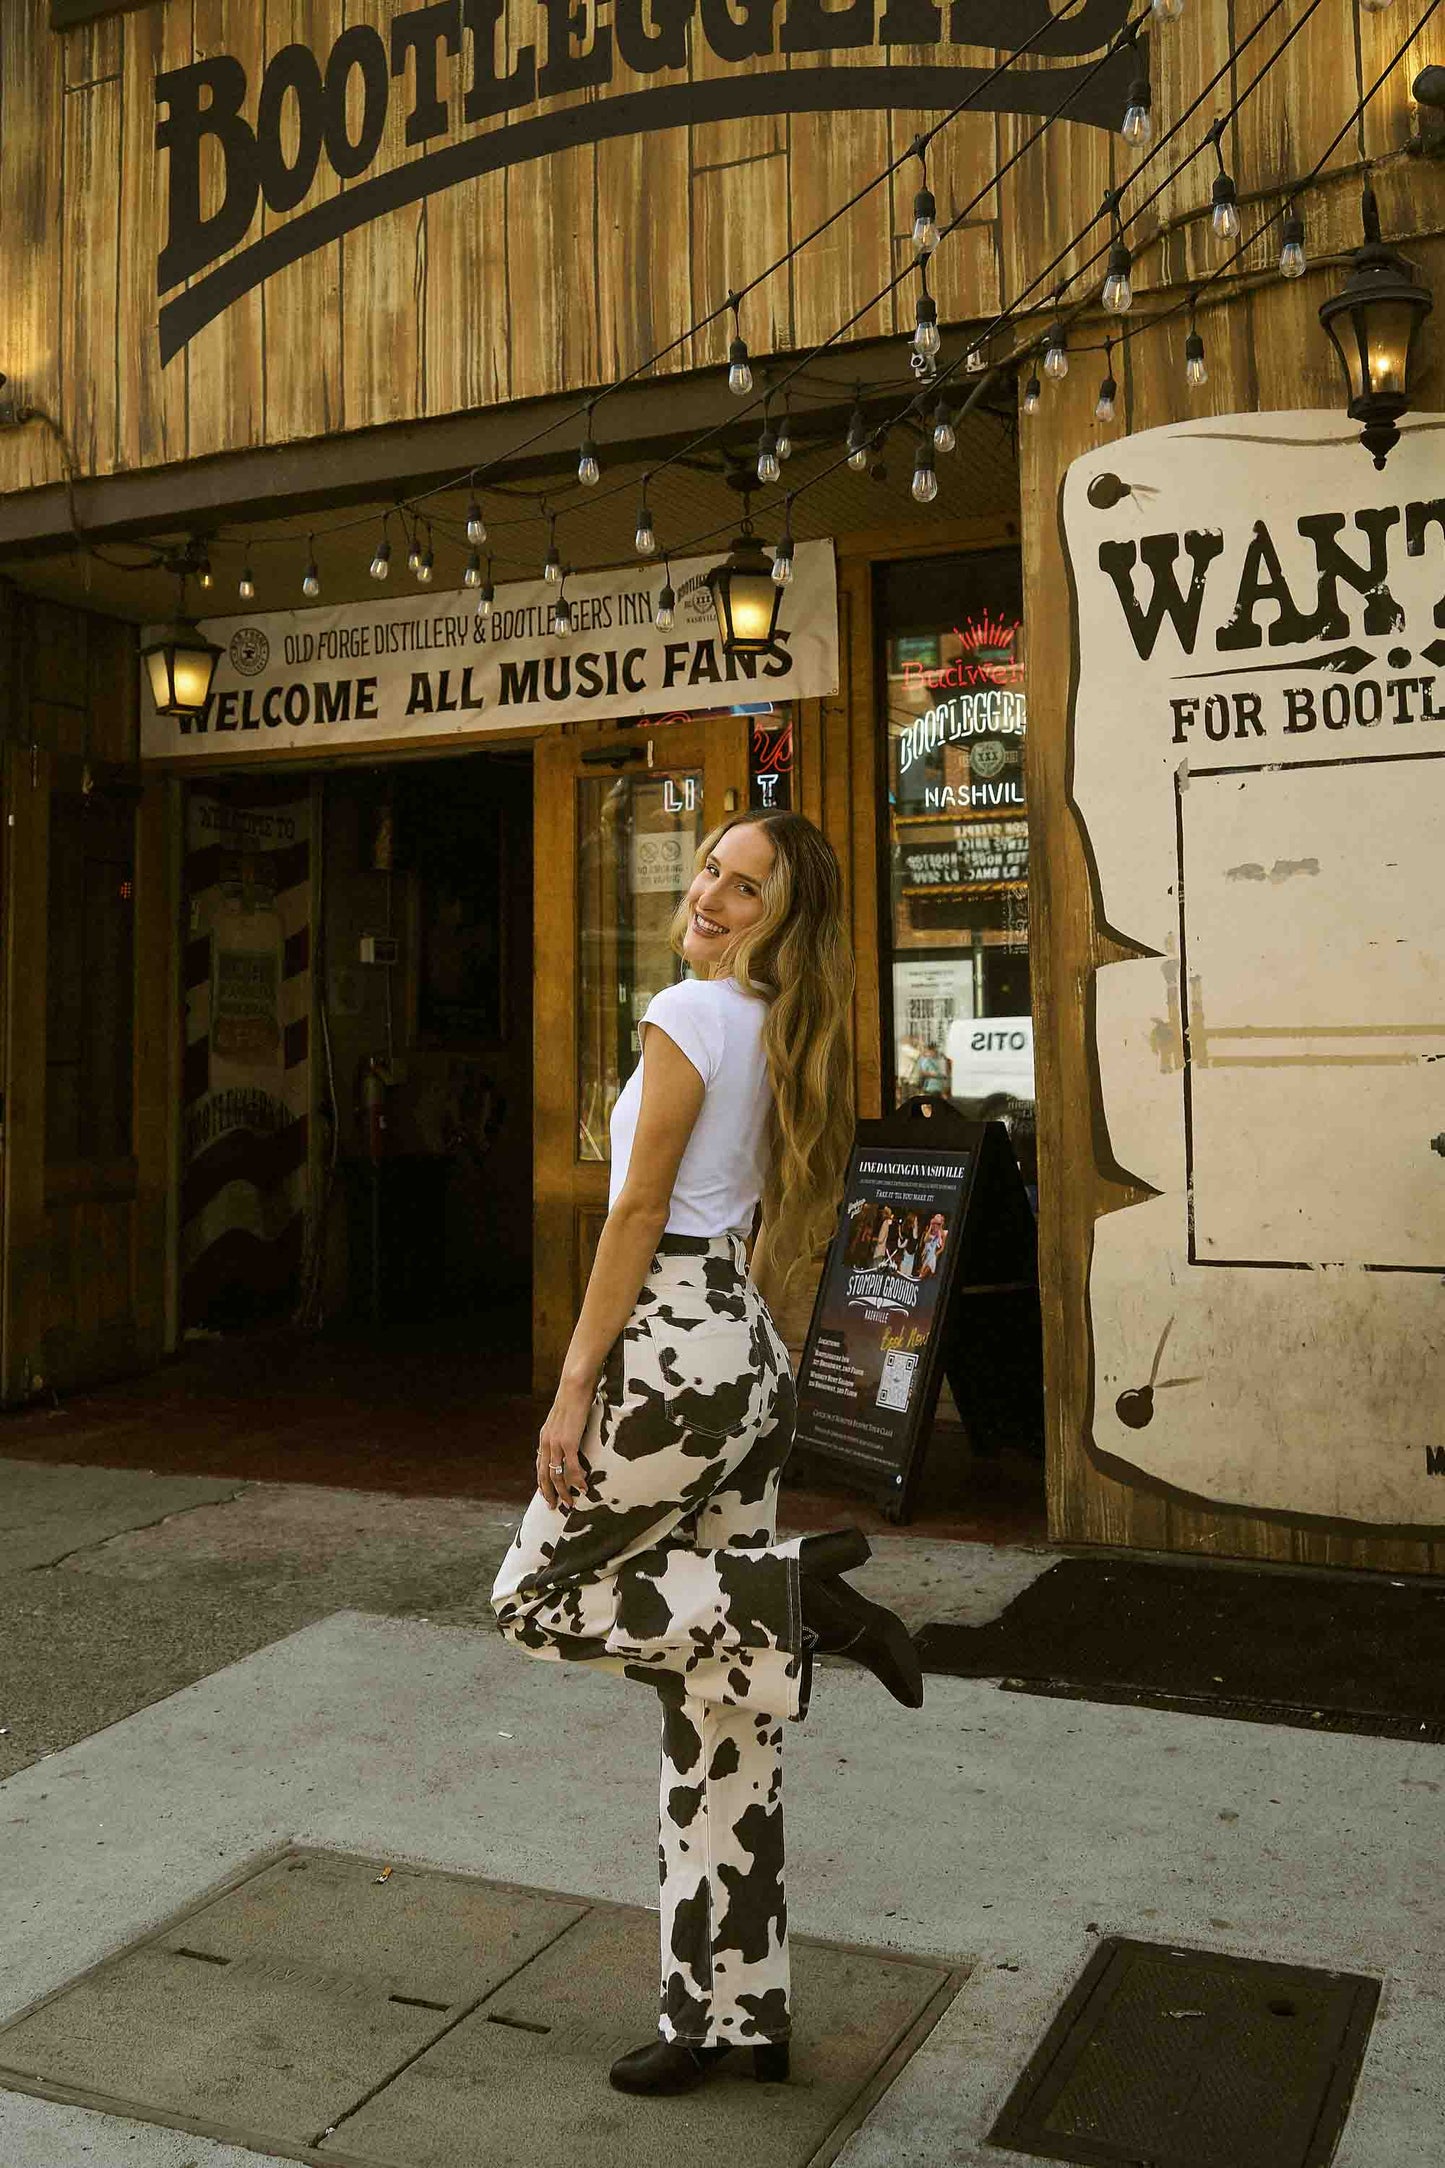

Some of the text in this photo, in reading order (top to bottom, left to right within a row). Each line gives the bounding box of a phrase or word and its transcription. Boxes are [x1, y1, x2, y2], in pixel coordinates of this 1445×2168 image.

[284, 635, 314, 665] OLD
[317, 626, 370, 660] FORGE
[375, 615, 469, 655] DISTILLERY
[473, 615, 487, 645] &
[491, 596, 613, 643] BOOTLEGERS
[618, 591, 653, 627] INN
[180, 629, 793, 735] WELCOME ALL MUSIC FANS
[1169, 676, 1445, 744] FOR BOOTL
[925, 782, 1024, 808] NASHVIL
[920, 1165, 965, 1179] NASHVILLE
[882, 1275, 919, 1307] GROUNDS
